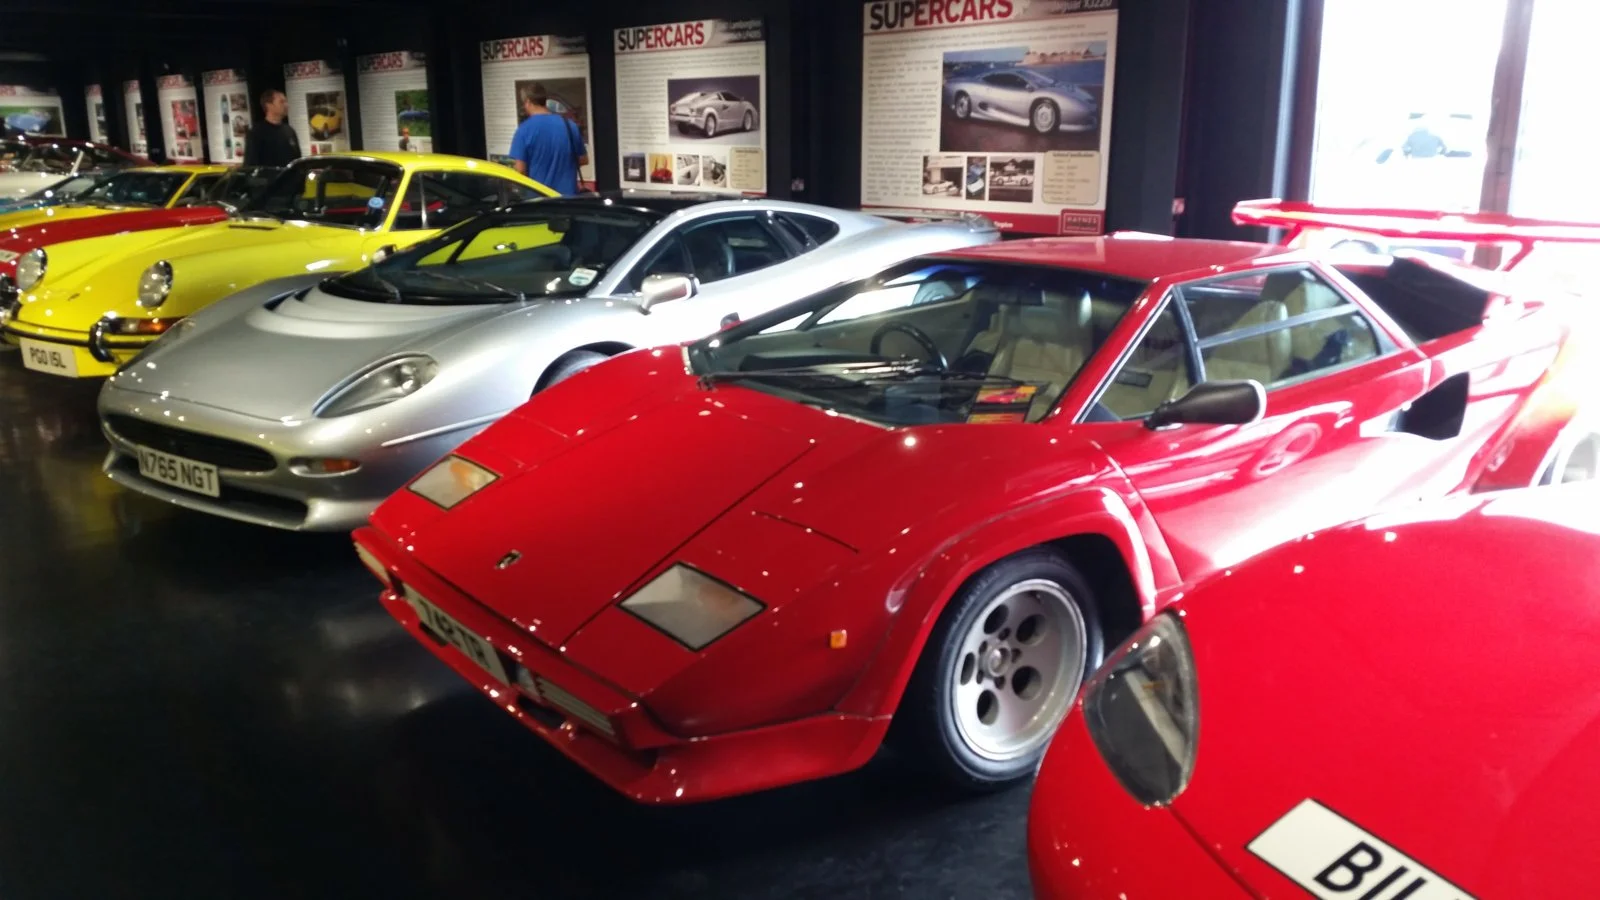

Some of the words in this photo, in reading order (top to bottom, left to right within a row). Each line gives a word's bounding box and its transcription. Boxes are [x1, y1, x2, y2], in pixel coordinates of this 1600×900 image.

[870, 0, 1014, 30] SUPERCARS
[483, 36, 544, 60] SUPERCARS
[618, 22, 704, 50] SUPERCARS
[139, 450, 177, 482] N765
[180, 462, 214, 491] NGT
